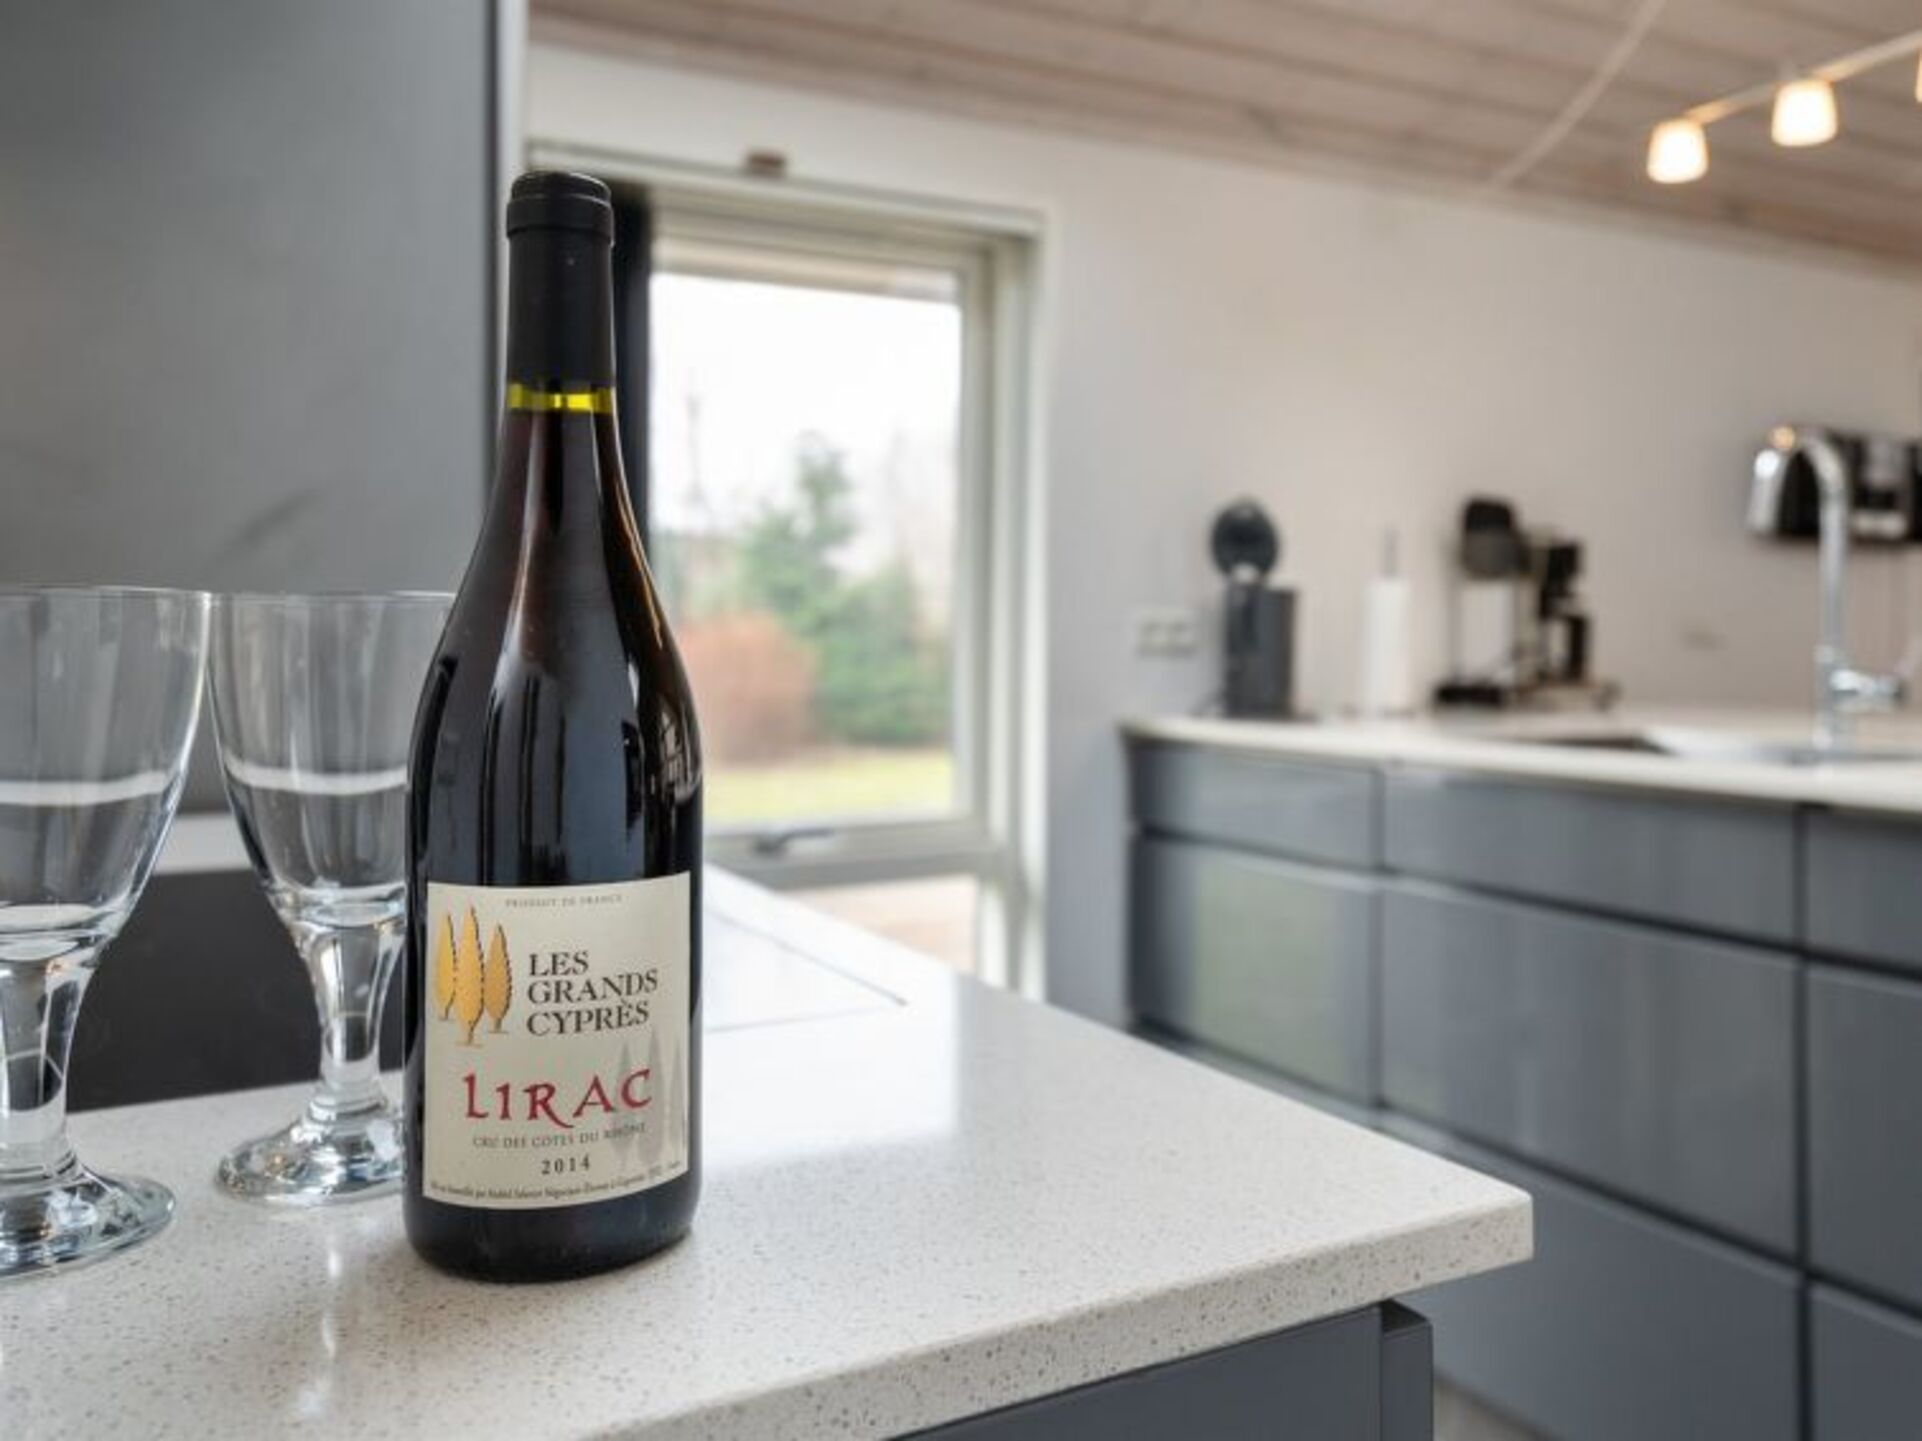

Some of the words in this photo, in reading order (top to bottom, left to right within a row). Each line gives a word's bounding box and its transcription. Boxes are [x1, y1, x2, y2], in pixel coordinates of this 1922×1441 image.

[529, 950, 589, 976] LES
[527, 969, 658, 1004] GRANDS
[526, 1000, 649, 1036] CYPRÈS
[463, 1069, 652, 1128] LIRAC
[579, 1132, 600, 1144] DU
[541, 1153, 590, 1174] 2014
